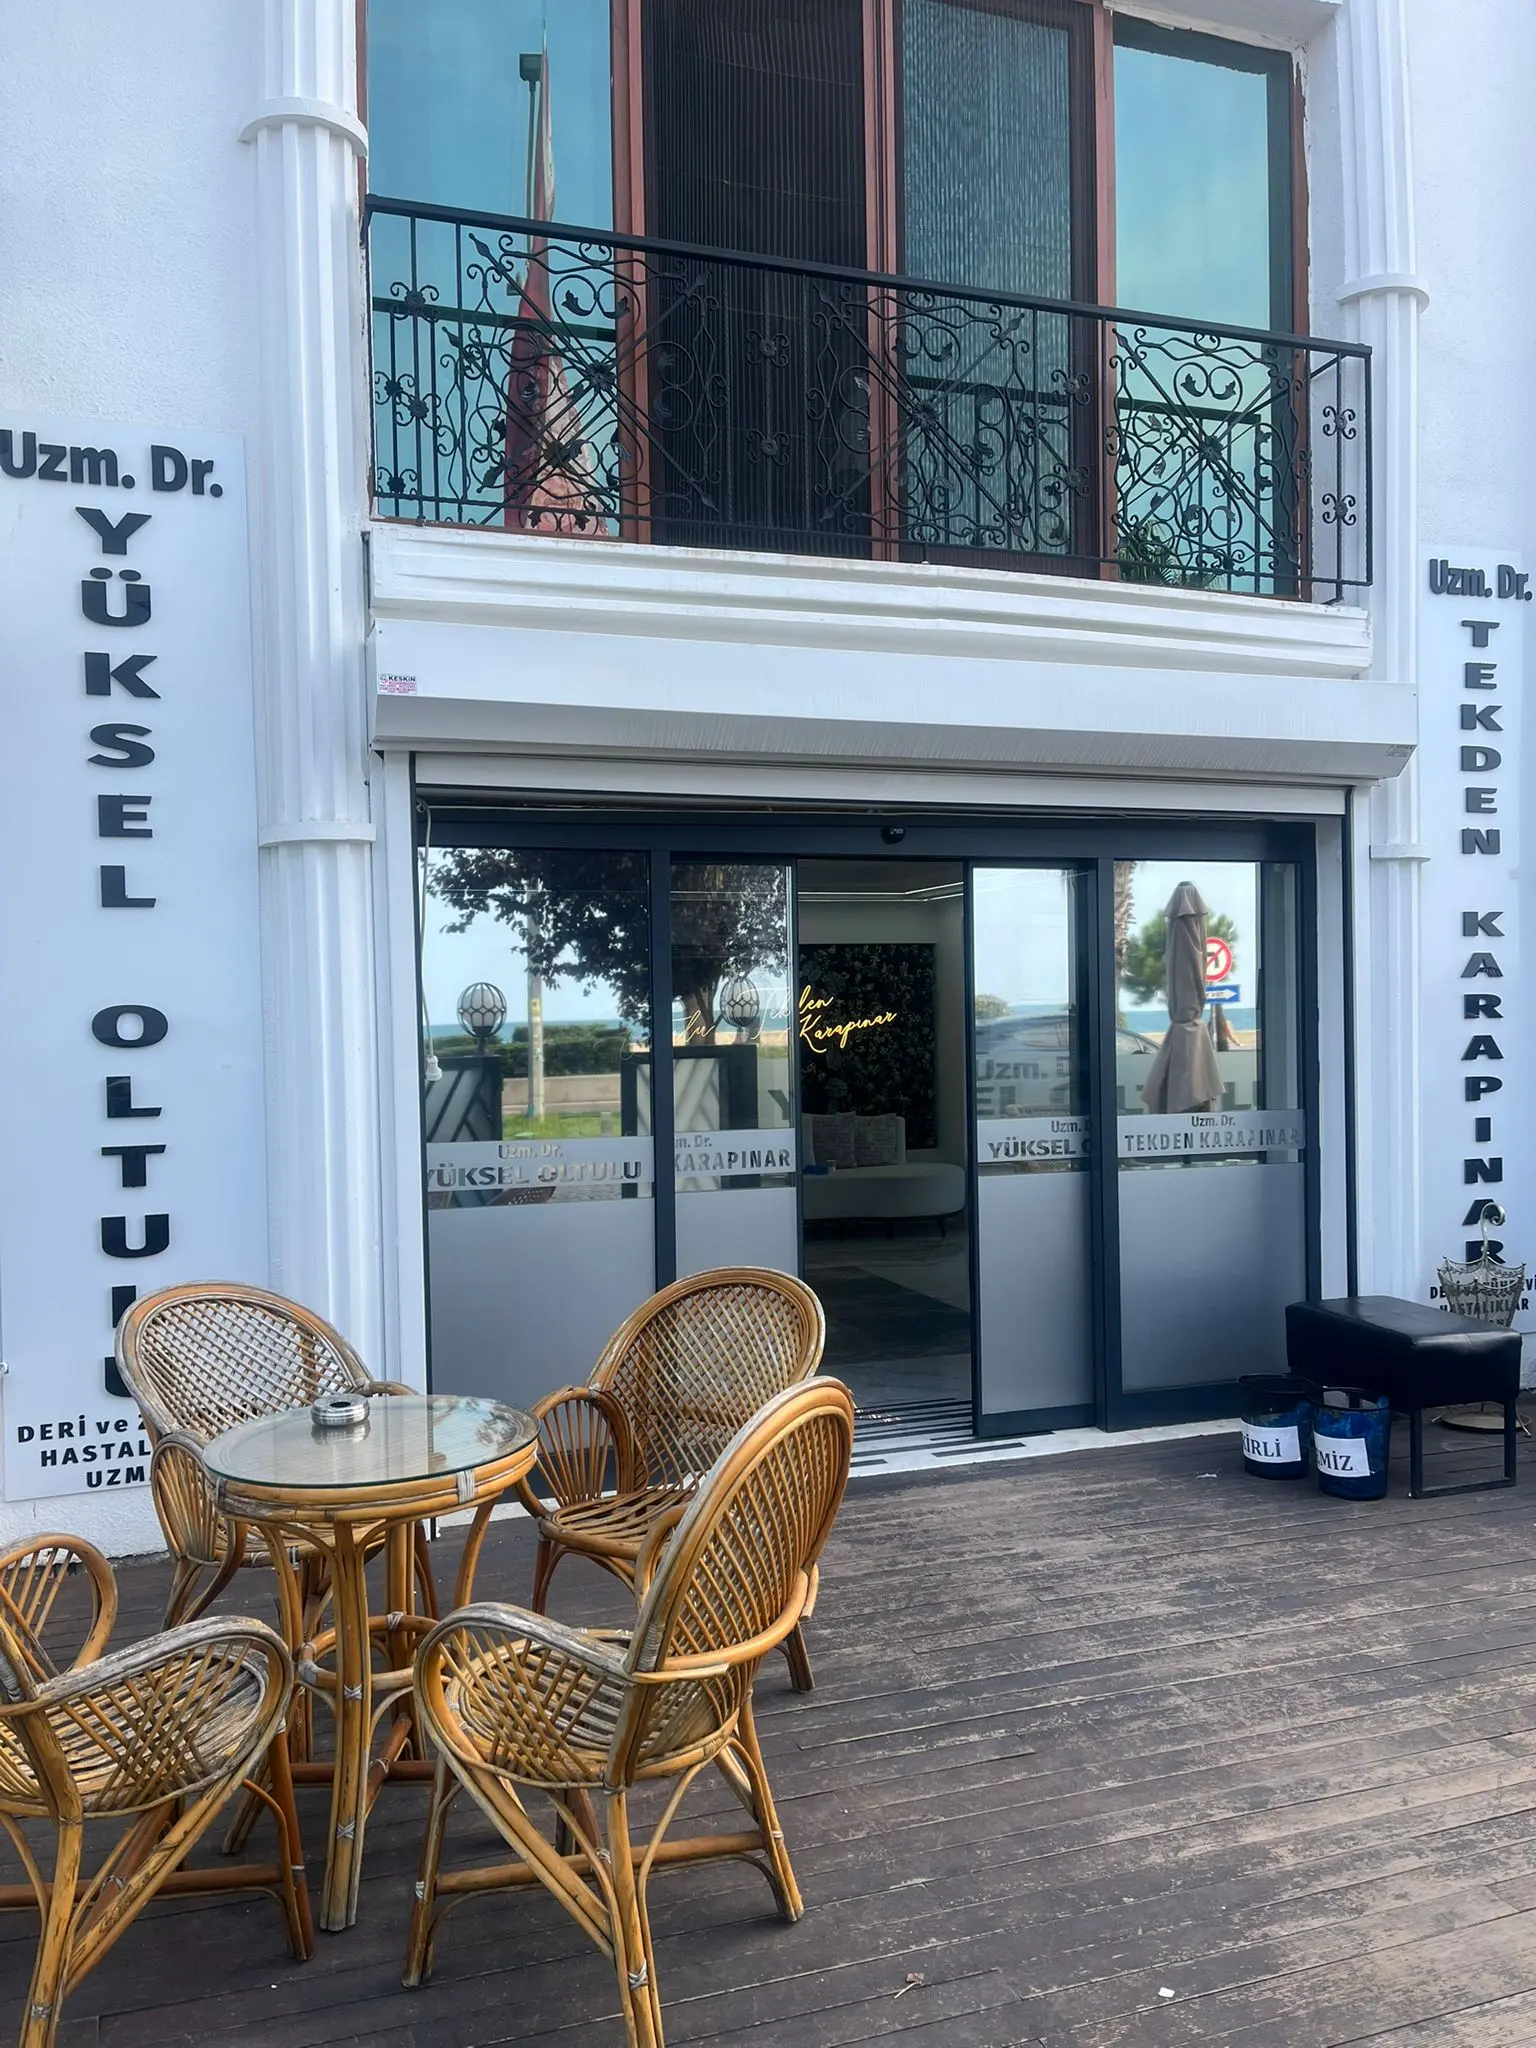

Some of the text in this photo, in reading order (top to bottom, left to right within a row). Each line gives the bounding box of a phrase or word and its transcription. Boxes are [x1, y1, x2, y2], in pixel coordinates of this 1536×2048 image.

[0, 429, 223, 498] Uzm. Dr.
[1429, 558, 1533, 601] Uzm. Dr.
[76, 507, 161, 907] YÜKSEL
[1460, 620, 1506, 1265] TEKDEN KARAPINAR
[1051, 1120, 1082, 1133] Uzm.
[1190, 1115, 1237, 1128] Uzm. Dr.
[694, 1134, 712, 1147] Dr.
[987, 1136, 1076, 1159] YÜKSEL
[1125, 1128, 1300, 1151] TEKDEN KARAPINAR
[498, 1144, 538, 1160] Uzm.
[538, 1161, 641, 1183] OLTULU
[18, 1414, 86, 1443] DERİ
[96, 1418, 128, 1435] ve
[41, 1440, 151, 1468] HASTAL
[86, 1465, 151, 1489] UZM
